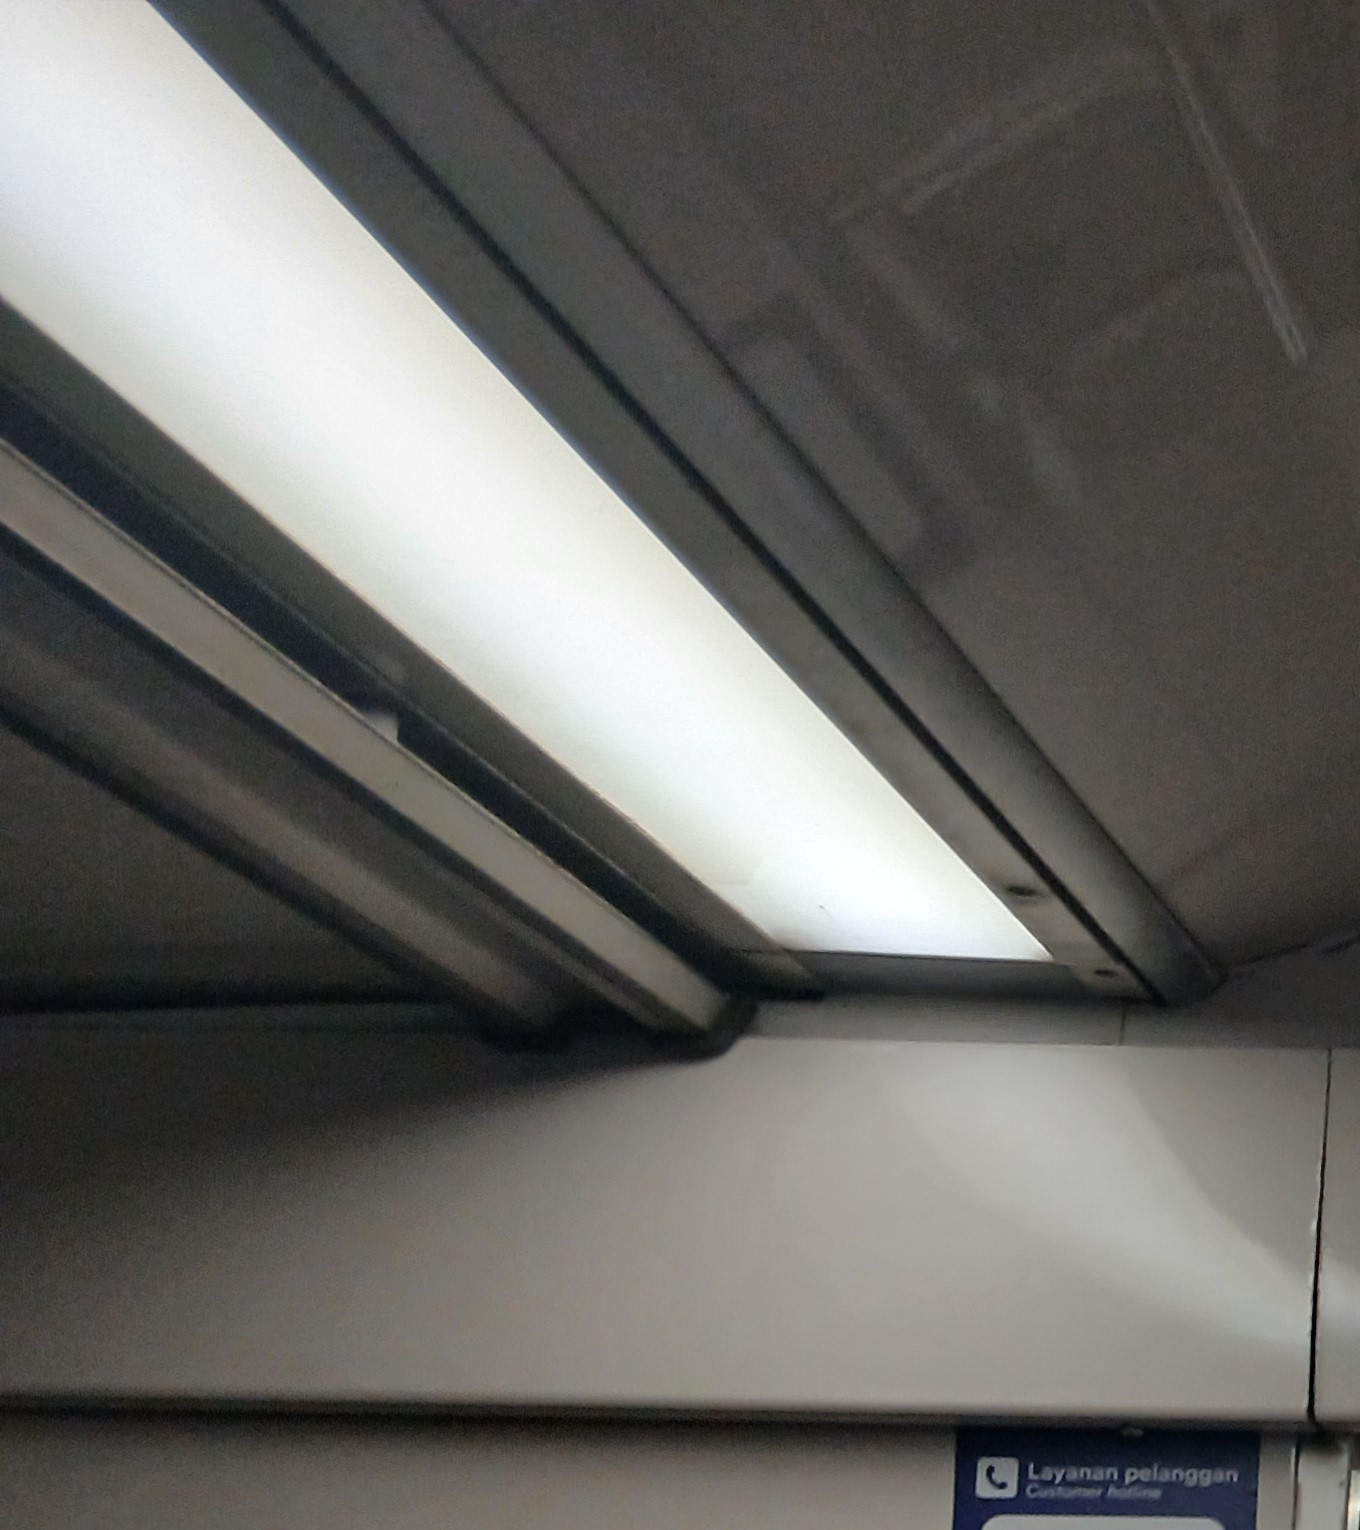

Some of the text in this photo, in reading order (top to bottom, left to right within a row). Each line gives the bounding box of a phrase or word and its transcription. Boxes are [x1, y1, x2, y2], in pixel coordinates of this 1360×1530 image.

[1028, 1462, 1239, 1487] Layanan pelanggan
[1026, 1483, 1102, 1499] Customer
